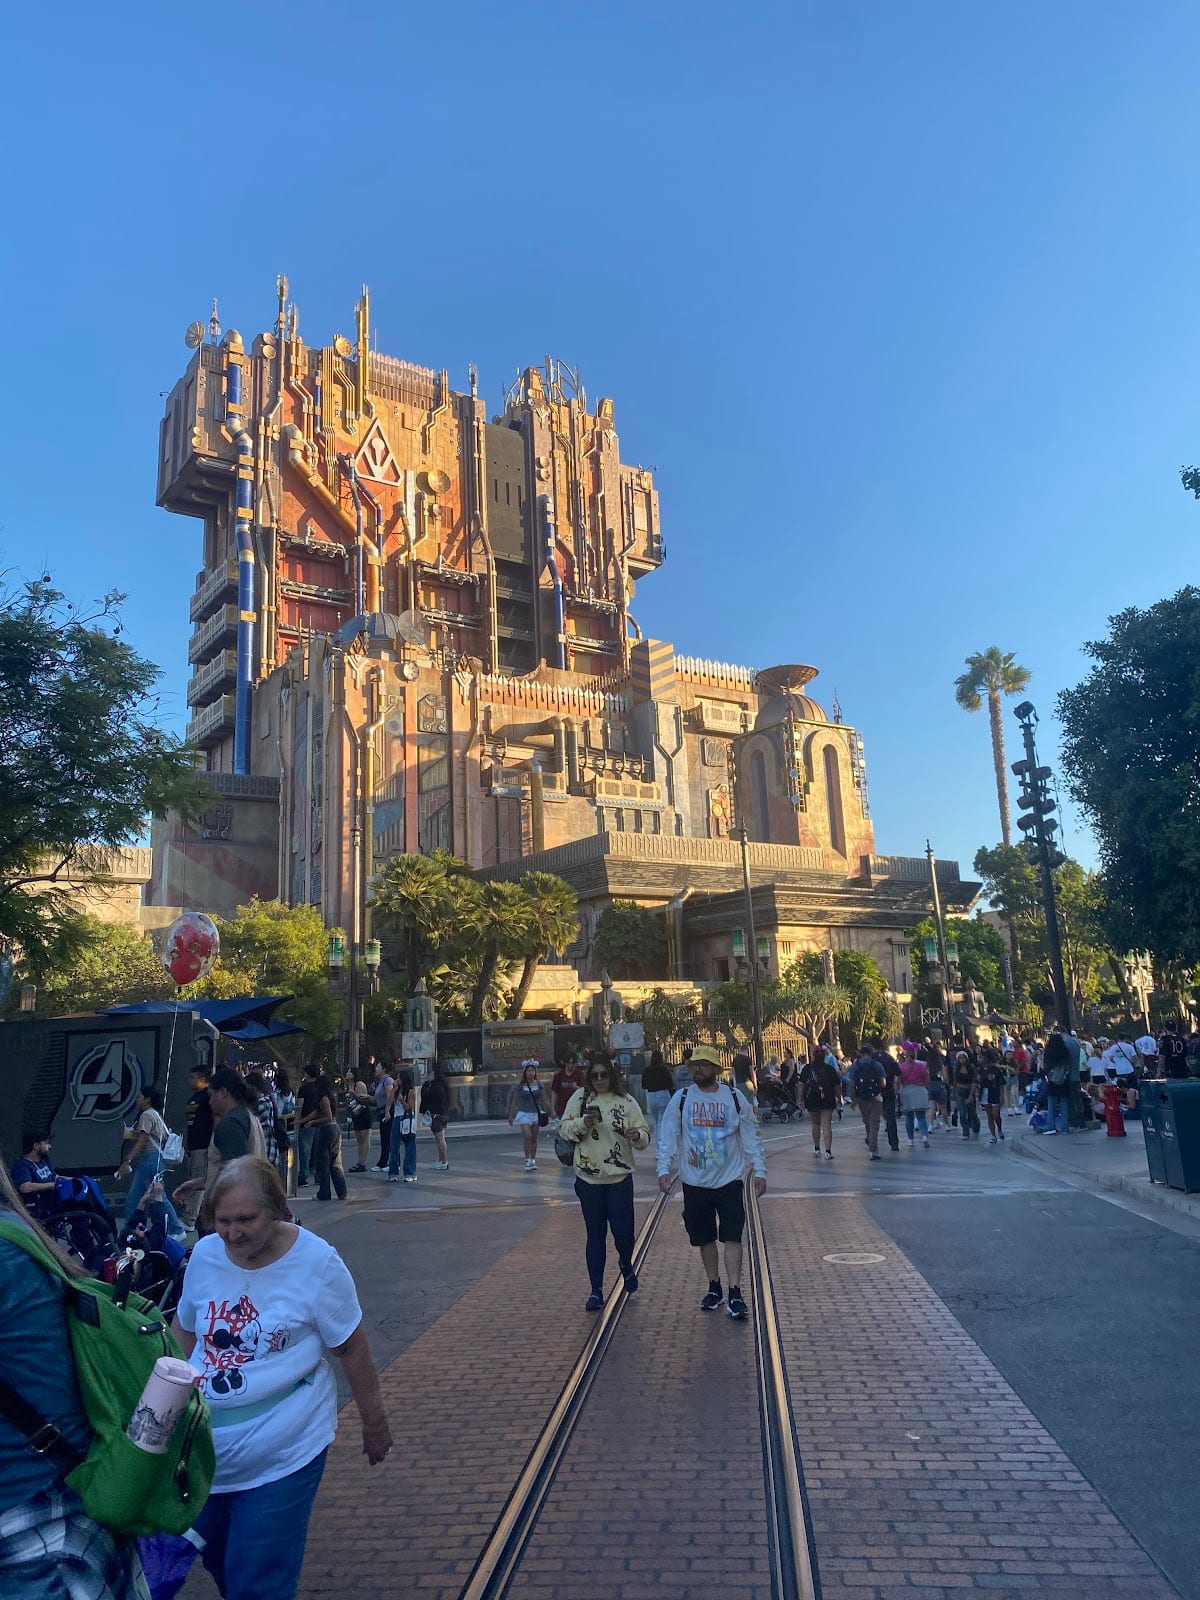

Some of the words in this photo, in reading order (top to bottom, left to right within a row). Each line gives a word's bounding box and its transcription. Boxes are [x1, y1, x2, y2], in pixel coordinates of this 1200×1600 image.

[1170, 1039, 1184, 1054] 10
[692, 1101, 726, 1121] PARIS
[194, 1300, 229, 1391] MINNE
